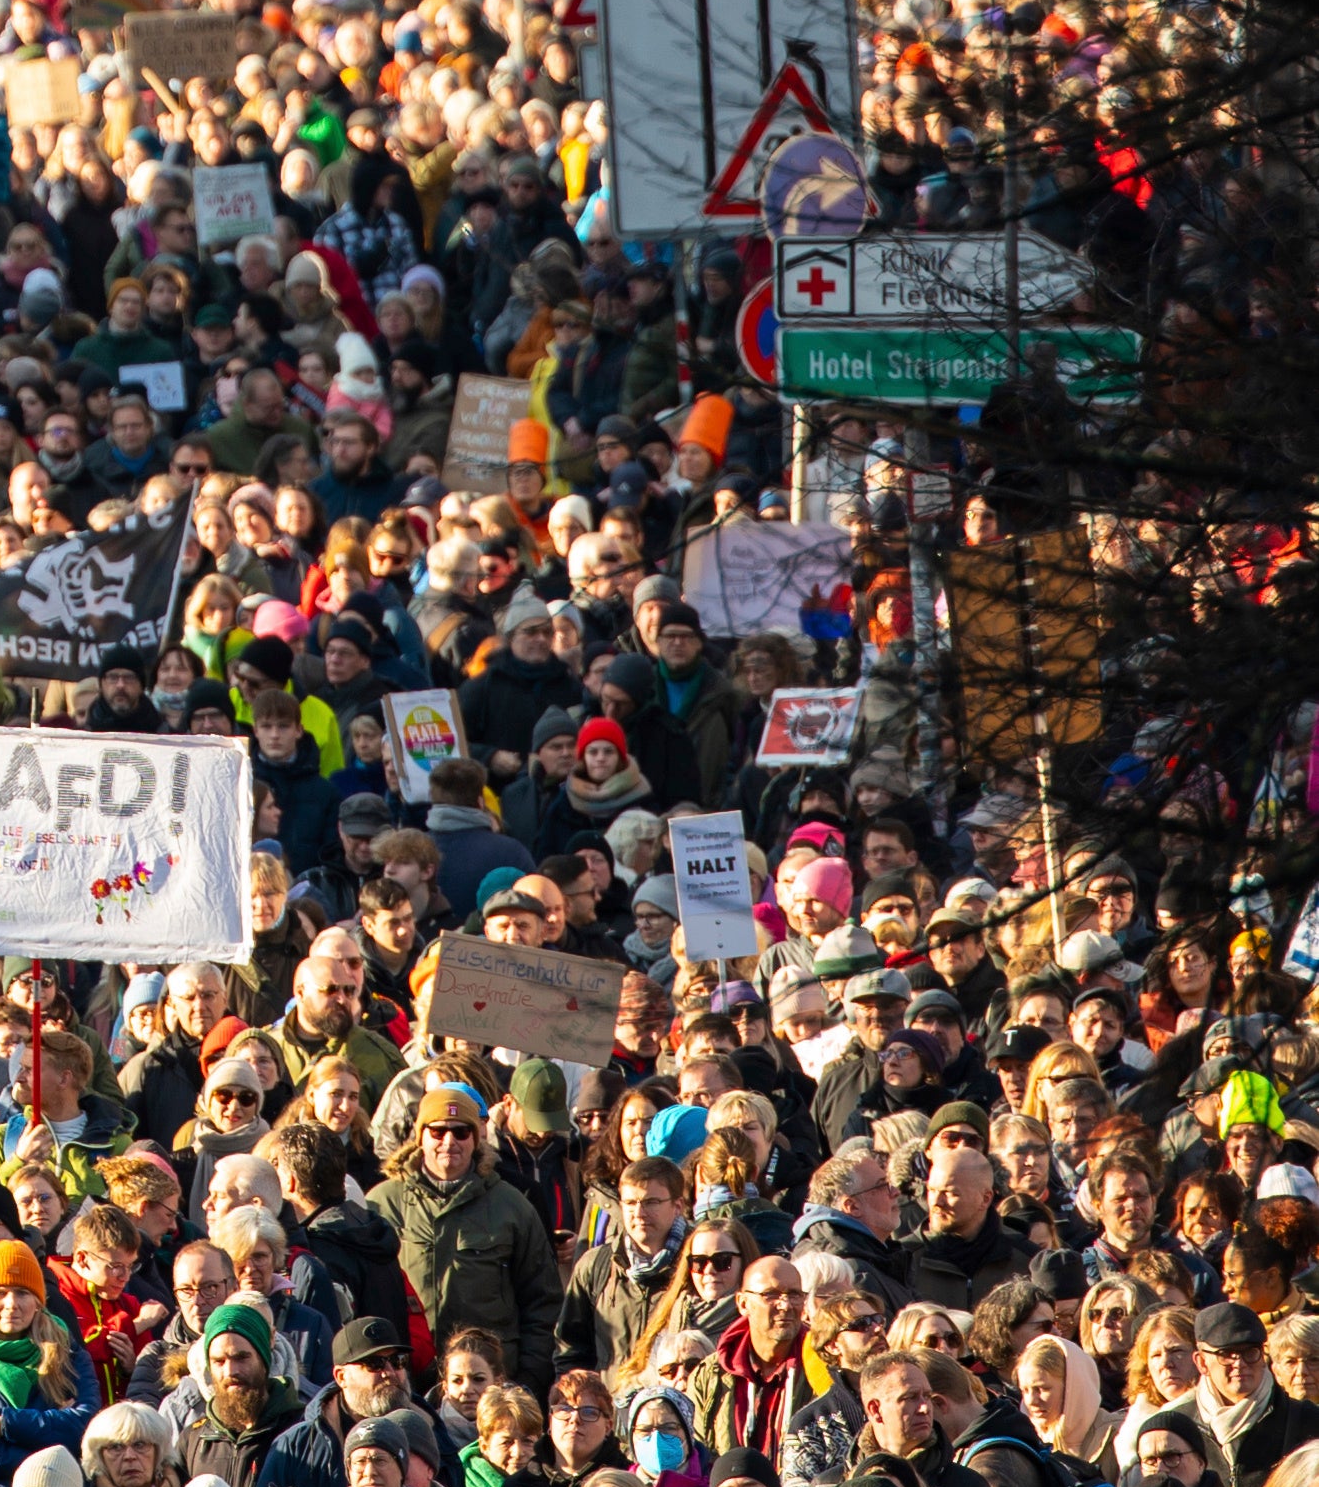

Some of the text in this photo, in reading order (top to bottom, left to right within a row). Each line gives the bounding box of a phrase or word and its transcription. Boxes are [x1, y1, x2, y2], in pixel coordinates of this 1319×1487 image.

[880, 249, 952, 275] Klinik
[881, 281, 1007, 308] Fleetinse
[808, 349, 874, 380] Hotel
[686, 855, 737, 876] HALT
[434, 967, 533, 1009] Demokratie
